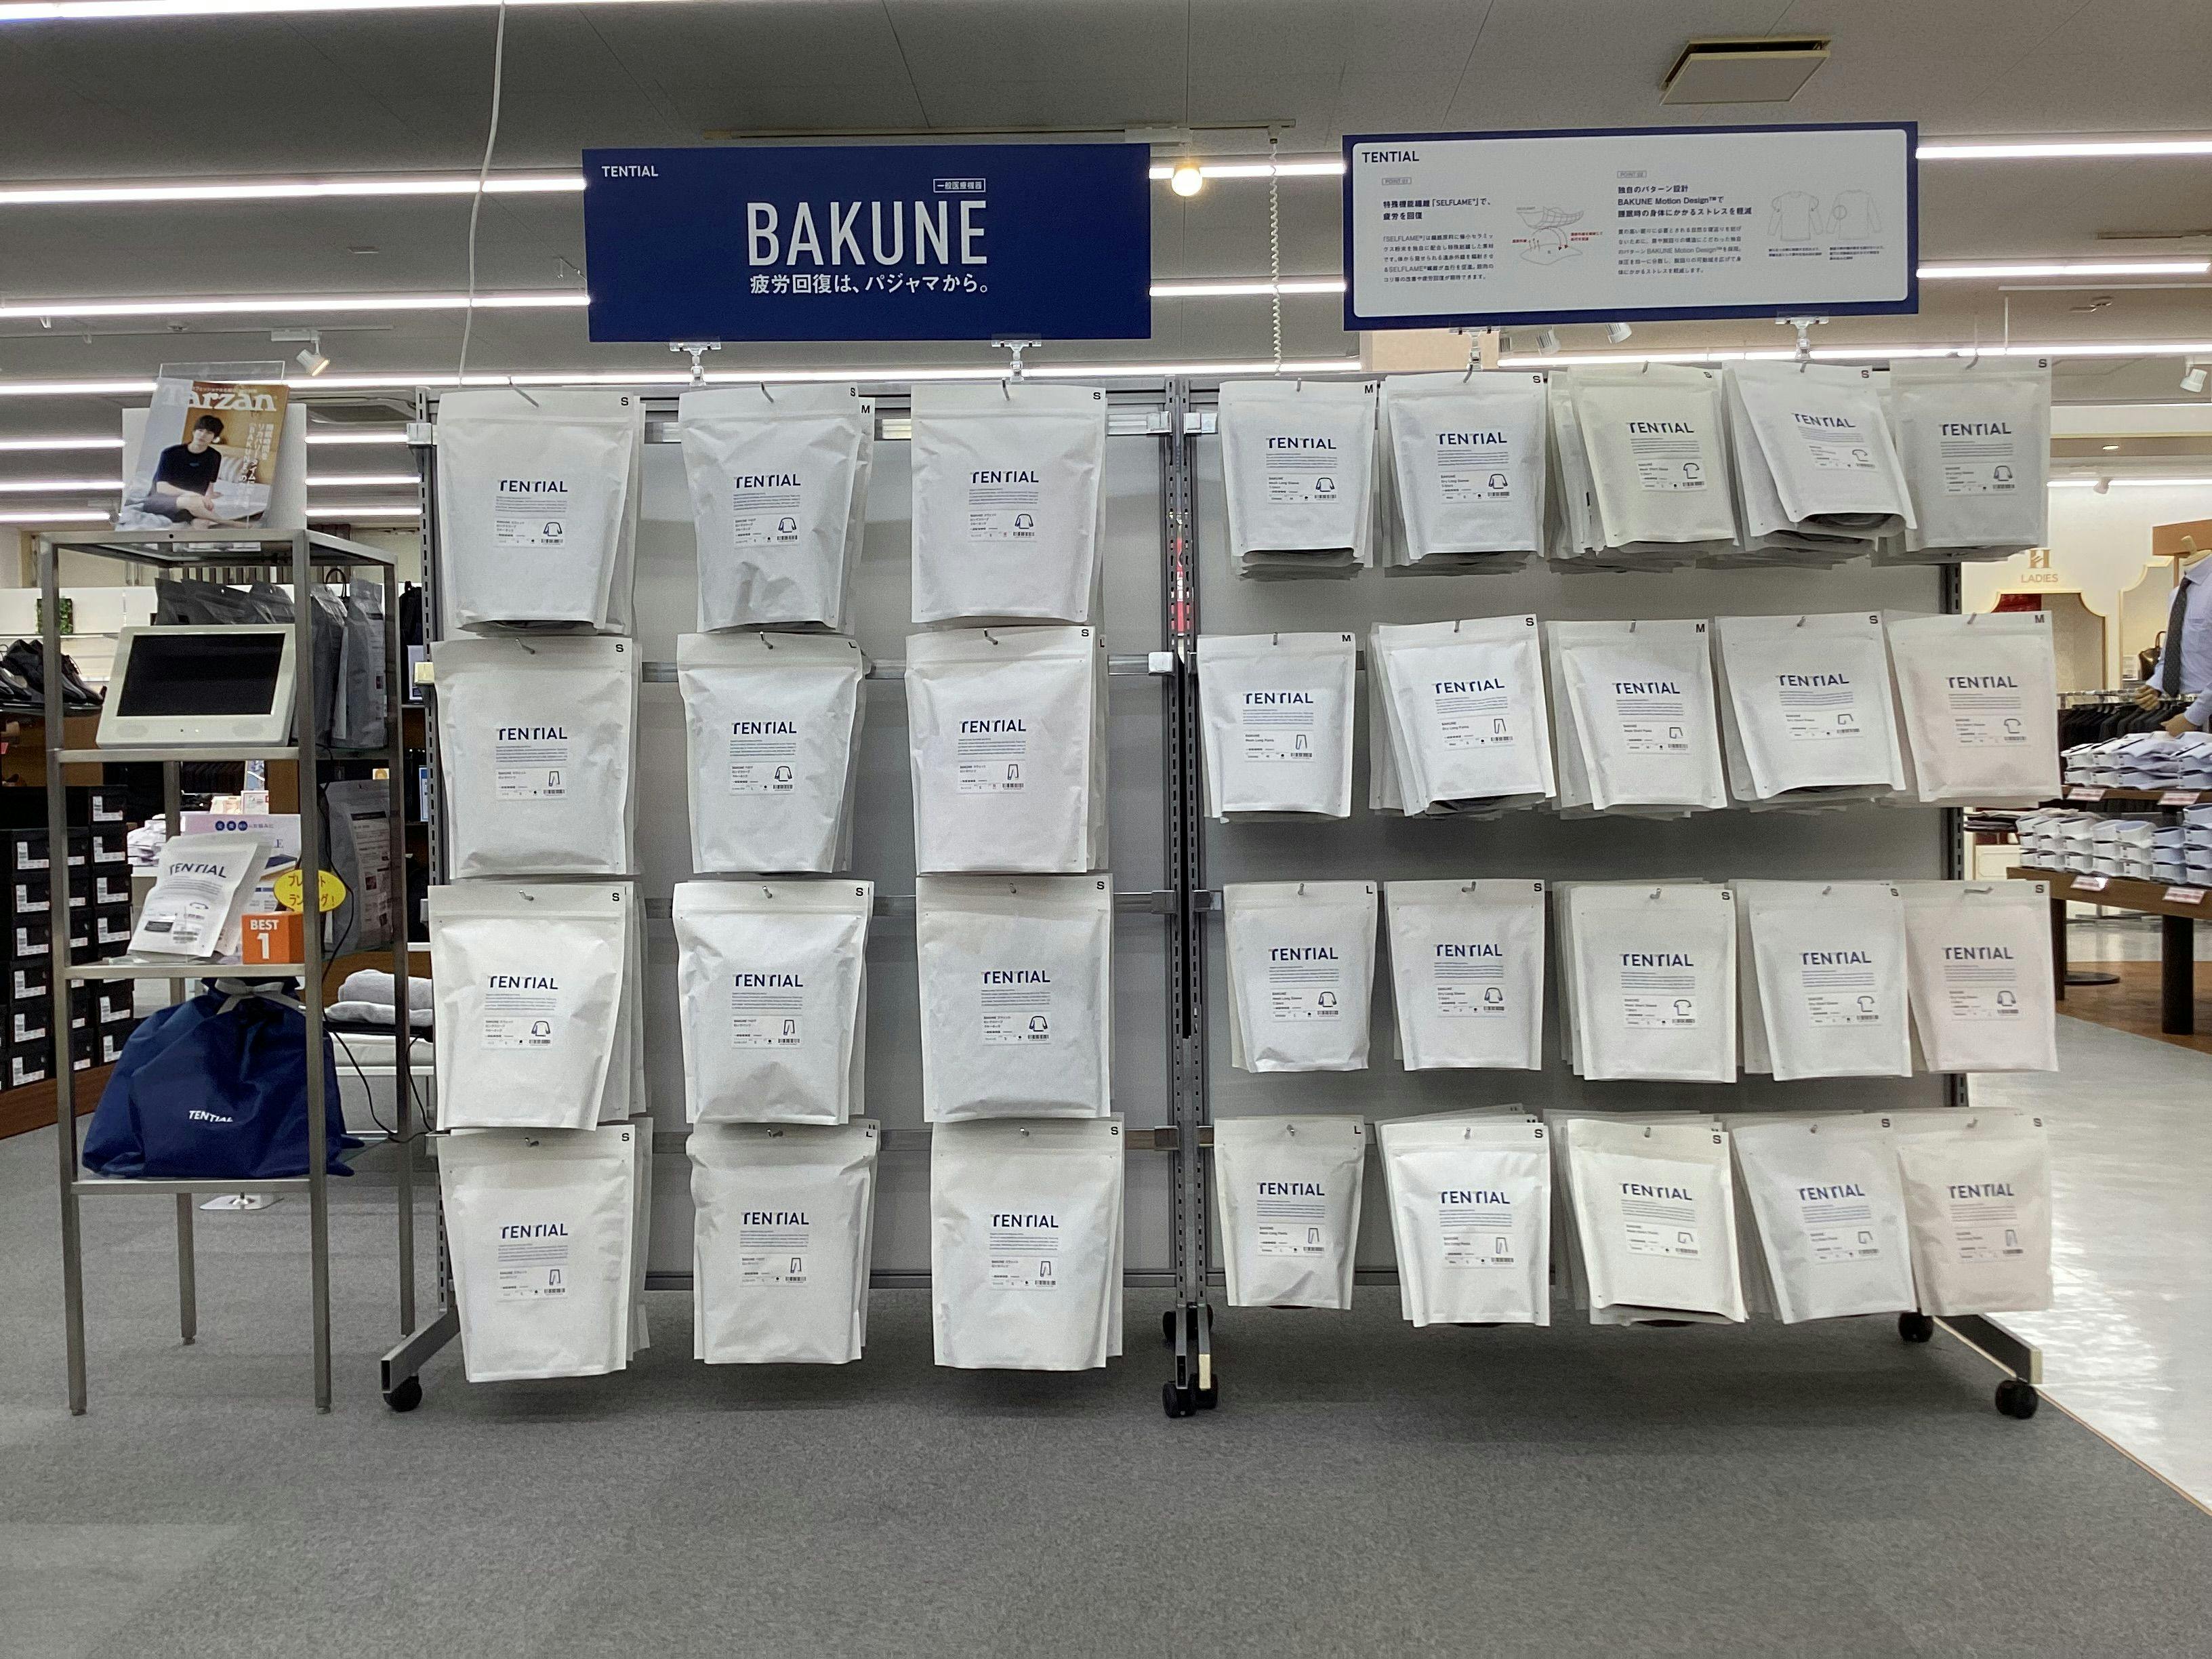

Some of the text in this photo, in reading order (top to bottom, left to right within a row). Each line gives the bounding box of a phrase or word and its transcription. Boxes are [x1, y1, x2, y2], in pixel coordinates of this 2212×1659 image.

[1361, 150, 1419, 163] TENTIAL
[602, 165, 659, 178] TENTIAL
[1618, 197, 1652, 205] BAKUNE
[746, 200, 987, 266] BAKUNE
[749, 272, 988, 295] 疲労回復は、パジャマから。
[2039, 359, 2047, 367] S
[1862, 370, 1869, 378] S
[851, 388, 855, 396] S
[1365, 384, 1373, 394] M
[163, 386, 276, 411] Tarzan
[621, 397, 628, 405] S
[861, 405, 869, 413] M
[1792, 413, 1856, 428] TENTIAL
[1627, 422, 1694, 433] TENTIAL
[1940, 423, 2011, 435] TENTIAL
[1266, 438, 1336, 449] TENTIAL
[1437, 432, 1507, 445] TENTIAL
[734, 474, 800, 488] TENTIAL
[970, 471, 1039, 483] TENTIAL
[497, 480, 567, 492] TENTIAL
[2021, 574, 2059, 583] LADIES
[1526, 618, 1534, 626] S
[1870, 615, 1878, 623] S
[2035, 615, 2045, 623] M
[1696, 623, 1704, 632] M
[1100, 639, 1105, 647] L
[1433, 678, 1504, 693] TENTIAL
[1776, 674, 1849, 687] TENTIAL
[1946, 676, 2018, 688] TENTIAL
[1614, 682, 1680, 694] TENTIAL
[1244, 693, 1313, 703] TENTIAL
[731, 722, 796, 734] TENTIAL
[959, 720, 1026, 733] TENTIAL
[497, 727, 567, 740] TENTIAL
[169, 863, 227, 878] TENTIAL
[1097, 881, 1104, 889] S
[1366, 886, 1373, 894] L
[1534, 883, 1542, 891] S
[2036, 884, 2044, 893] S
[613, 893, 619, 901] S
[856, 888, 863, 896] S
[1722, 892, 1729, 900] S
[250, 919, 279, 930] BEST
[257, 933, 270, 960] 1
[1434, 944, 1502, 956] TENTIAL
[1269, 947, 1338, 960] TENTIAL
[1800, 951, 1871, 964] TENTIAL
[1942, 947, 2013, 960] TENTIAL
[1620, 954, 1694, 966] TENTIAL
[487, 976, 558, 989] TENTIAL
[733, 975, 803, 987] TENTIAL
[982, 970, 1050, 983] TENTIAL
[1881, 1119, 1890, 1128] S
[1355, 1126, 1361, 1134] L
[1535, 1129, 1542, 1138] S
[622, 1133, 629, 1141] S
[1713, 1135, 1721, 1144] S
[1257, 1183, 1325, 1195] TENTIAL
[1620, 1183, 1692, 1200] TENTIAL
[1796, 1184, 1865, 1200] TENTIAL
[1946, 1184, 2014, 1198] TENTIAL
[1439, 1191, 1510, 1204] TENTIAL
[741, 1212, 809, 1225] TENTIAL
[991, 1214, 1059, 1227] TENTIAL
[499, 1223, 568, 1239] TENTIAL
